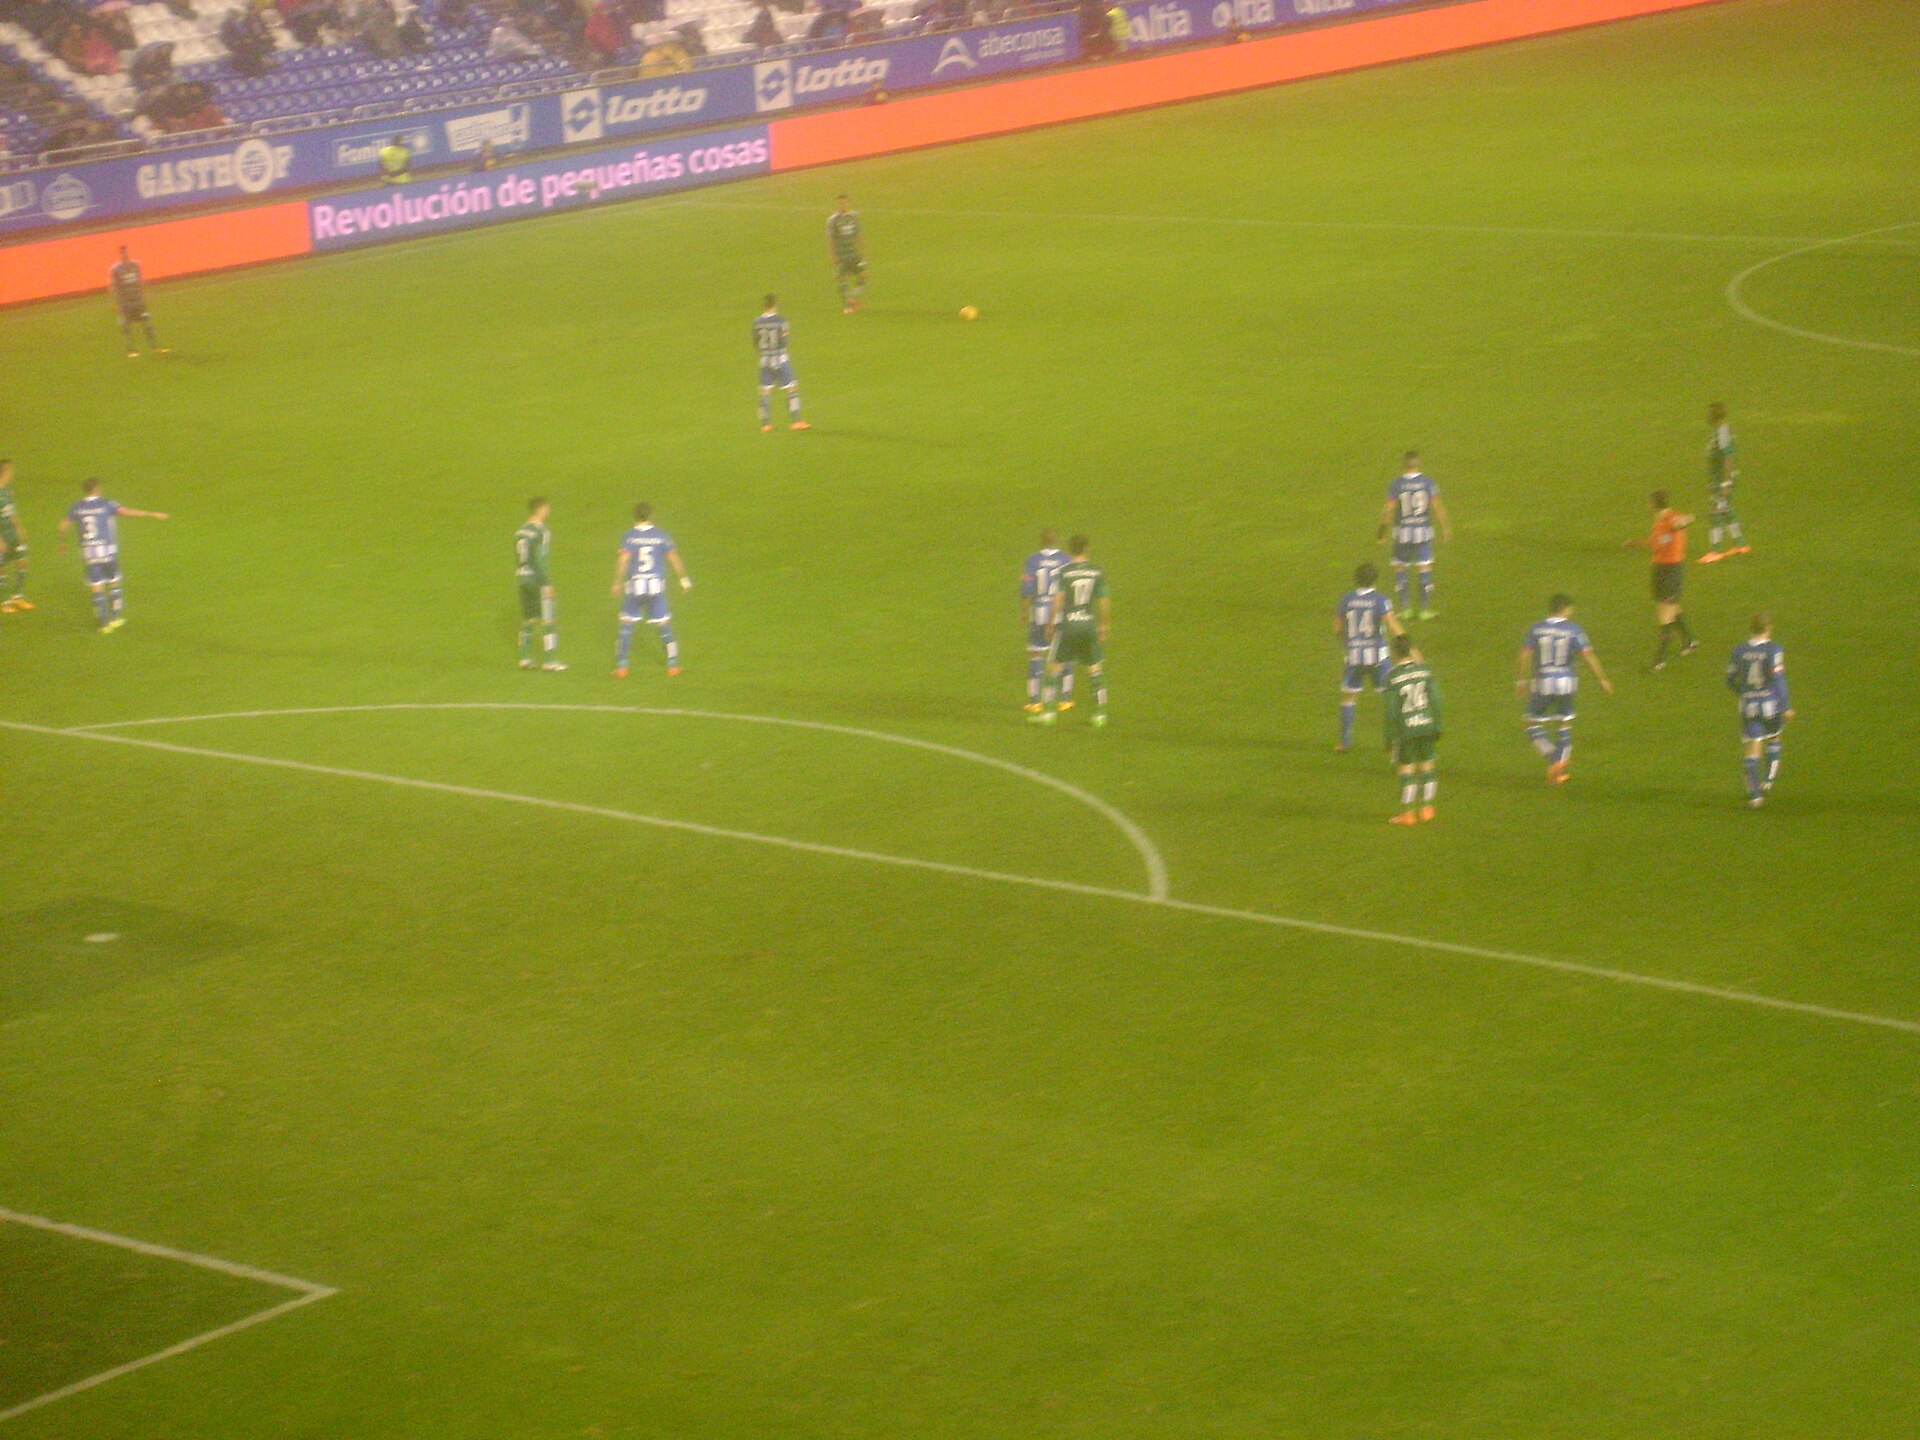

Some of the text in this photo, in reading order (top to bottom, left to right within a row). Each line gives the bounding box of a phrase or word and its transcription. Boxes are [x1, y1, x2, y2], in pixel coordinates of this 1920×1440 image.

[312, 138, 769, 240] Revolución de pequeñas cosas
[1398, 489, 1430, 517] 19
[82, 515, 98, 539] 3
[638, 545, 655, 573] 5
[1345, 609, 1377, 638] 14
[1537, 635, 1571, 667] 11
